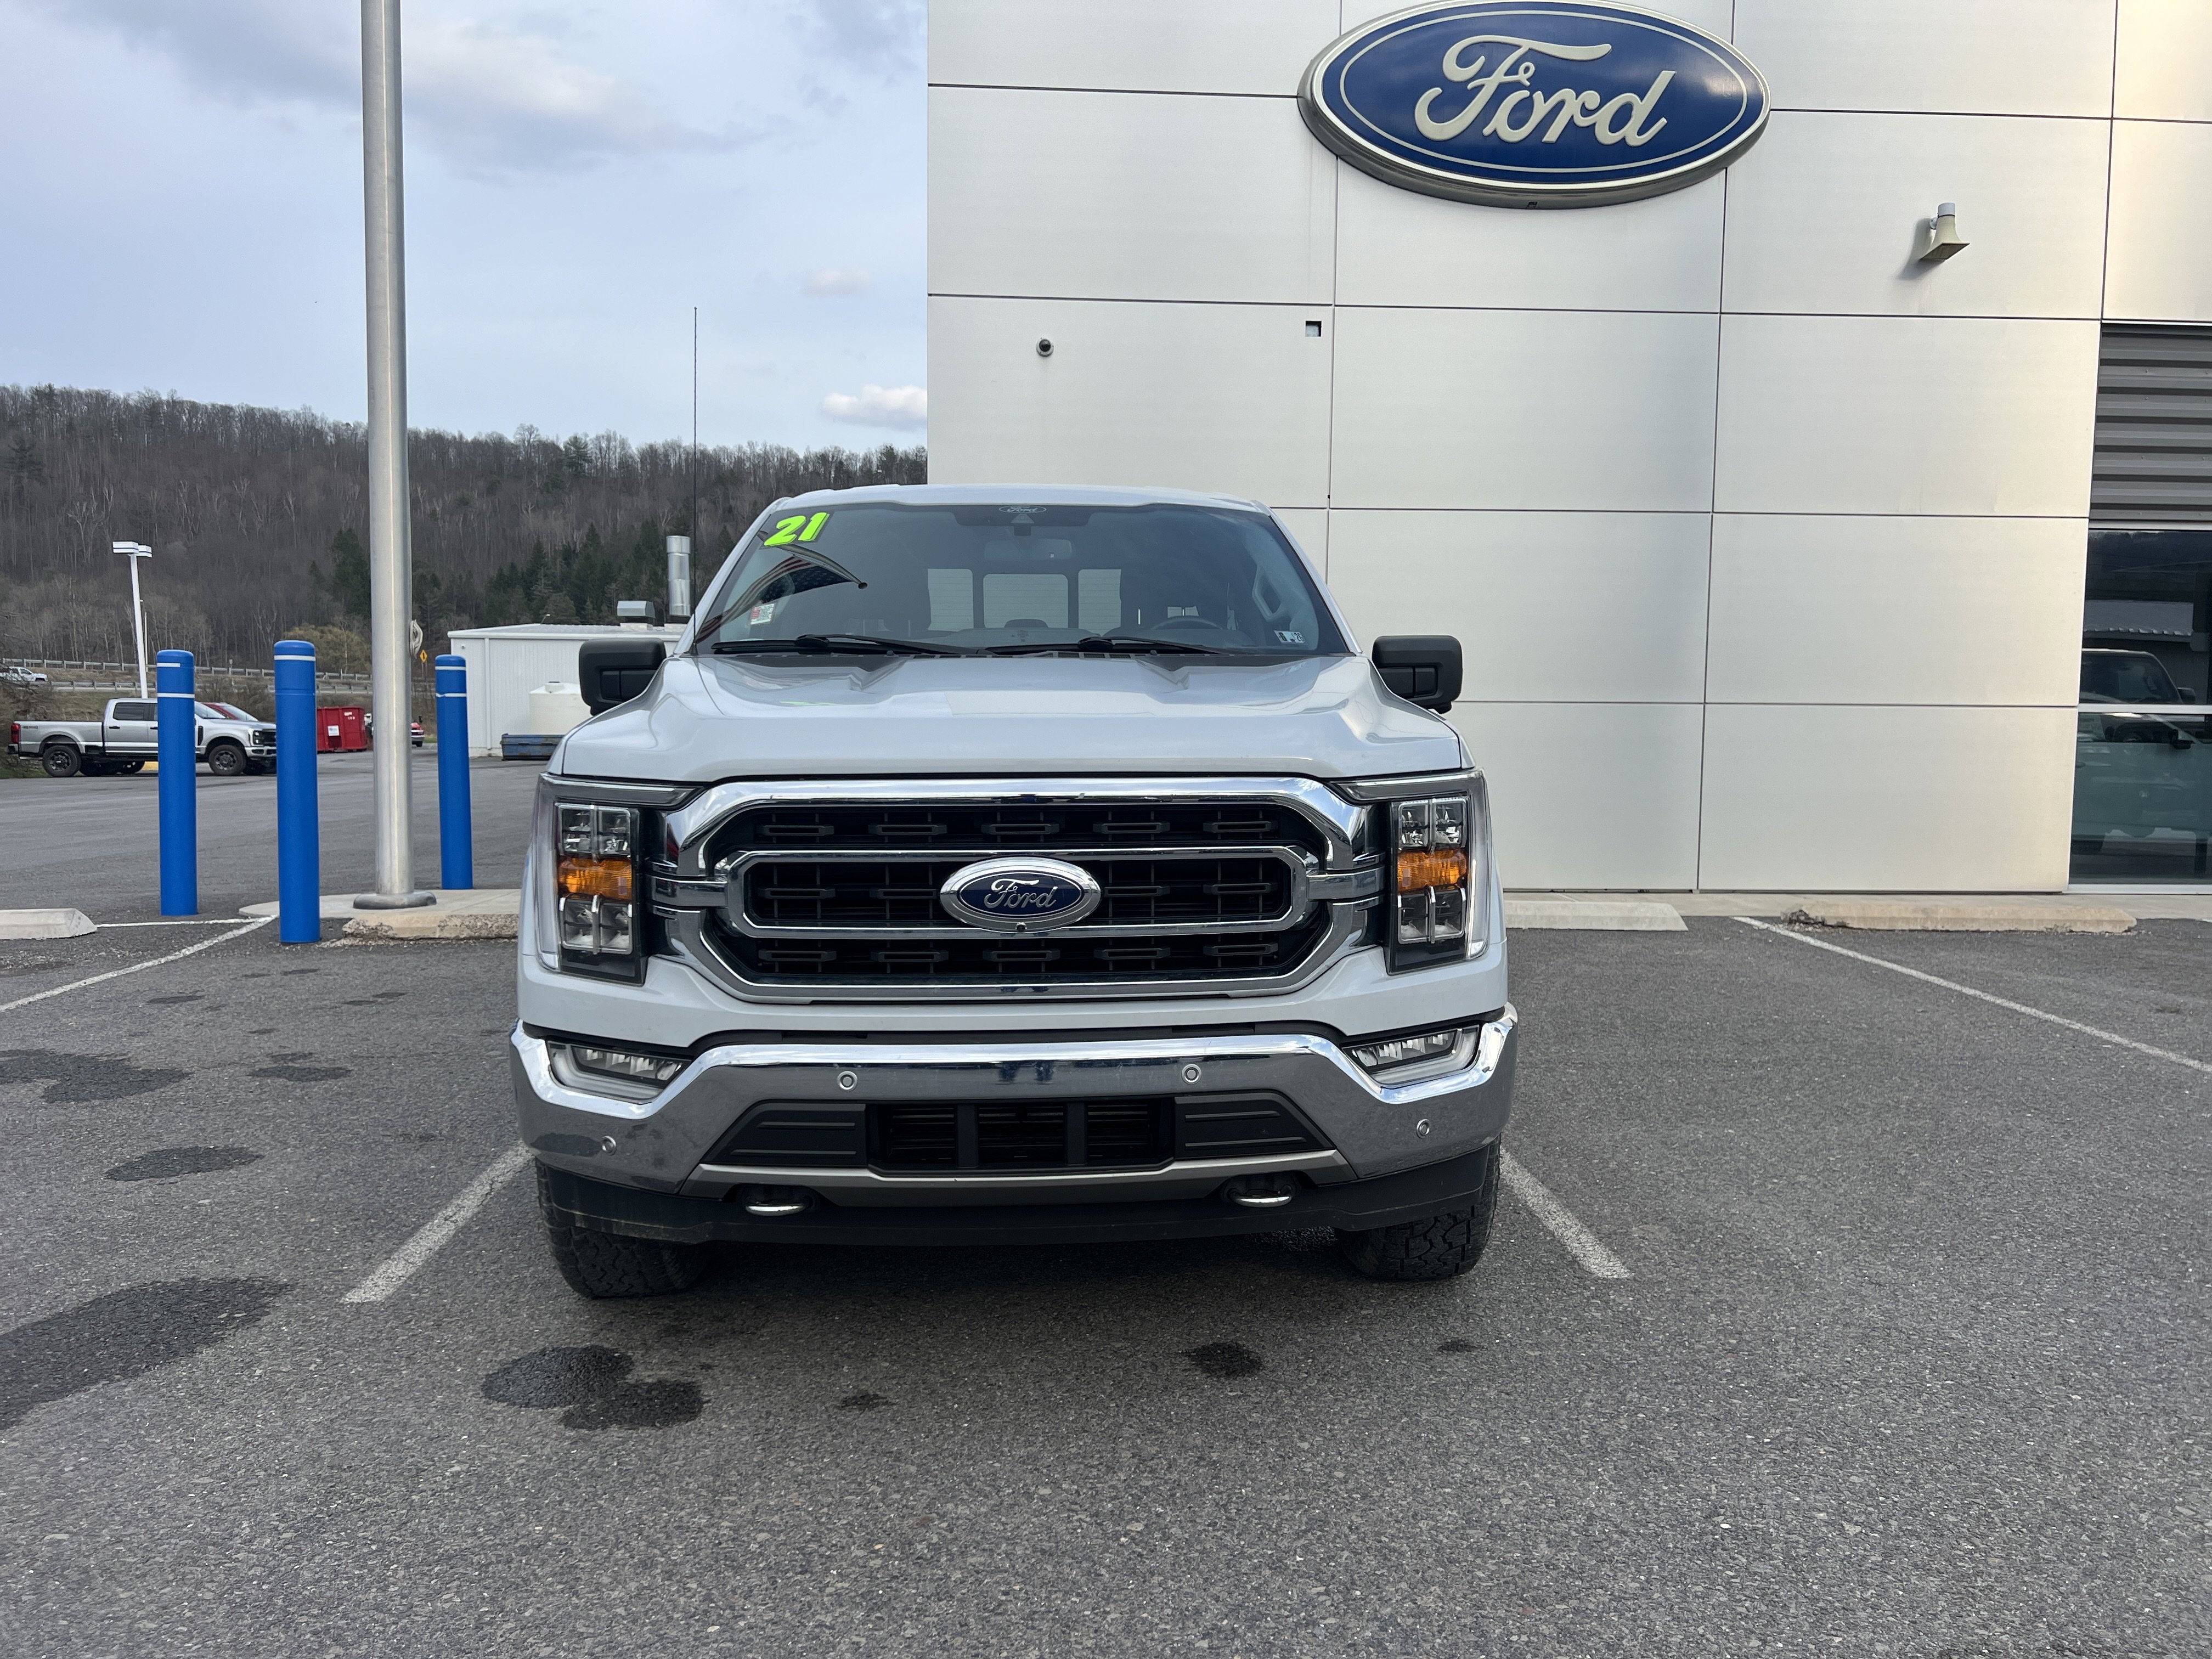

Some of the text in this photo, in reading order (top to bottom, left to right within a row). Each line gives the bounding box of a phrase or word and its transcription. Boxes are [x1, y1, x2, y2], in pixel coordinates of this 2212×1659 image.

[1414, 35, 1677, 148] Ford
[763, 512, 830, 546] 21
[983, 878, 1059, 909] Ford
